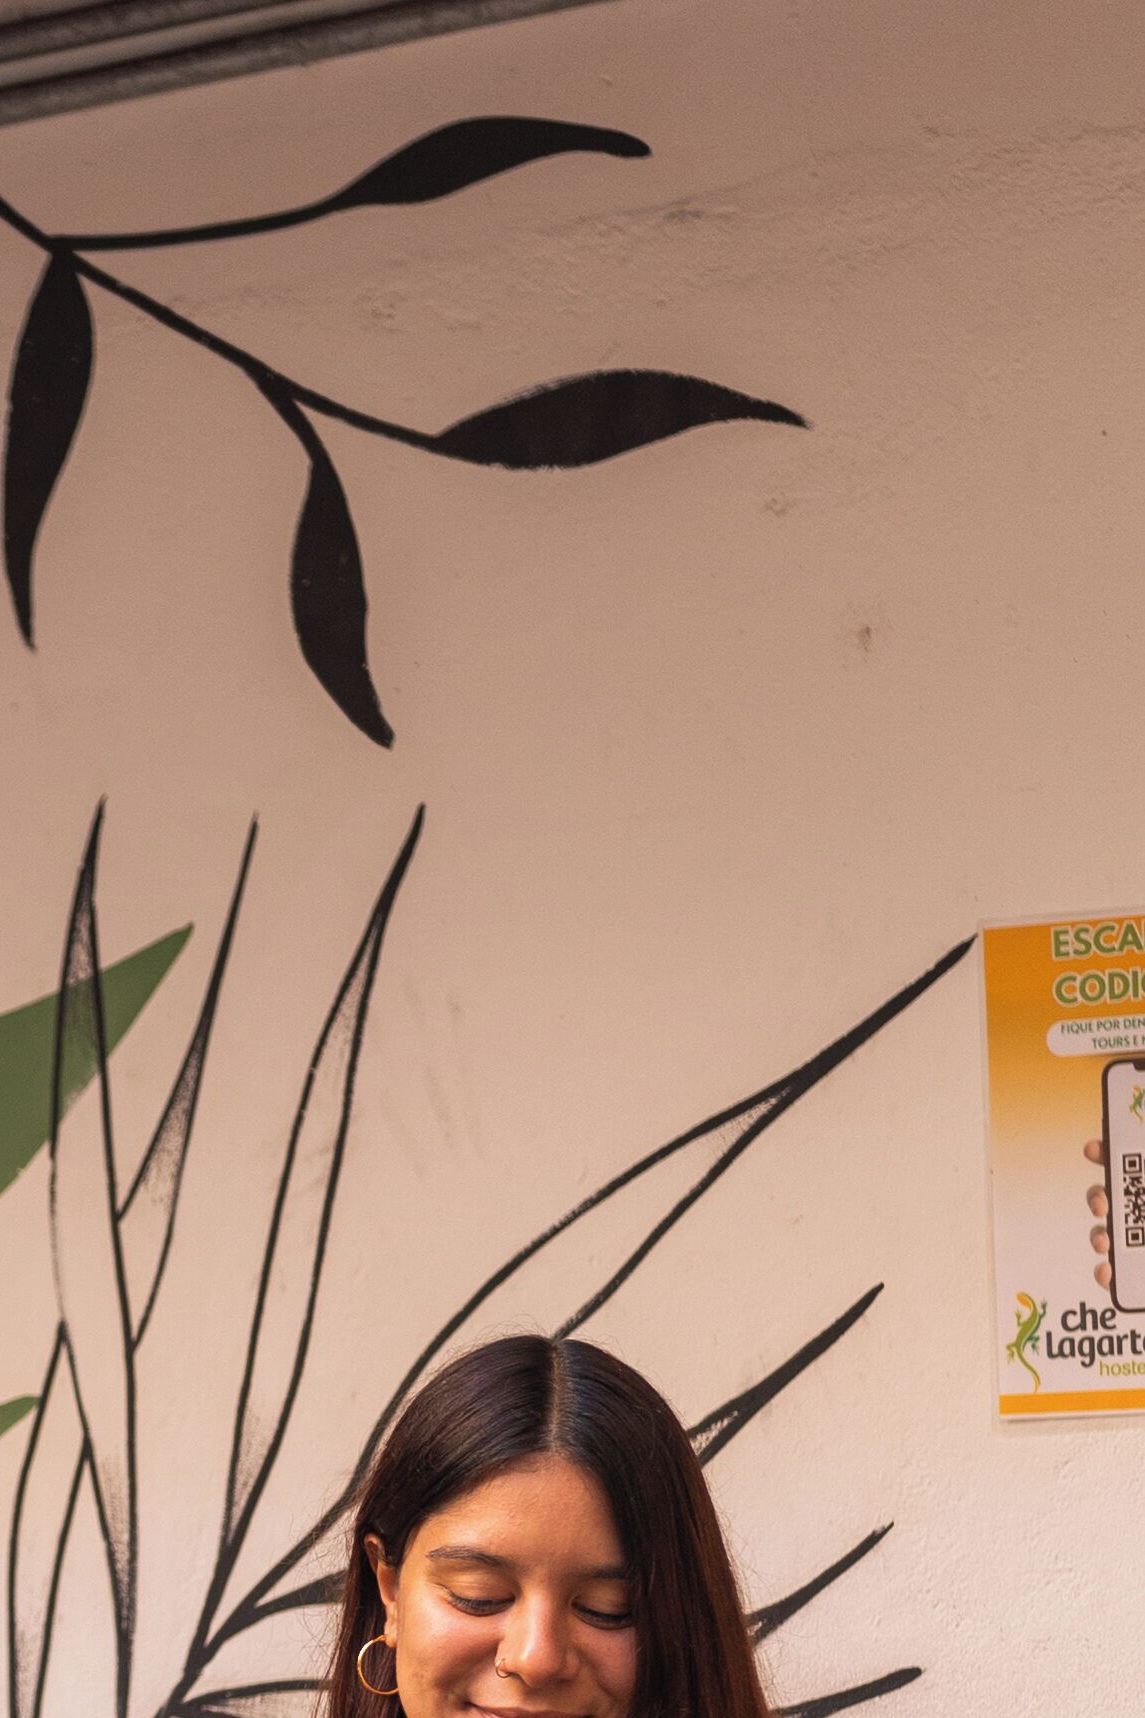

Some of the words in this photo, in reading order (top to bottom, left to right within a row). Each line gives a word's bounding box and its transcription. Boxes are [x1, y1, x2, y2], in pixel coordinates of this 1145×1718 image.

[1053, 921, 1145, 959] ESCA
[1053, 969, 1145, 1005] CODI
[1060, 1021, 1093, 1035] FIQUE
[1096, 1019, 1120, 1032] POR
[1093, 1035, 1130, 1050] TOURS
[1061, 1301, 1117, 1332] che
[1046, 1329, 1145, 1369] lagart
